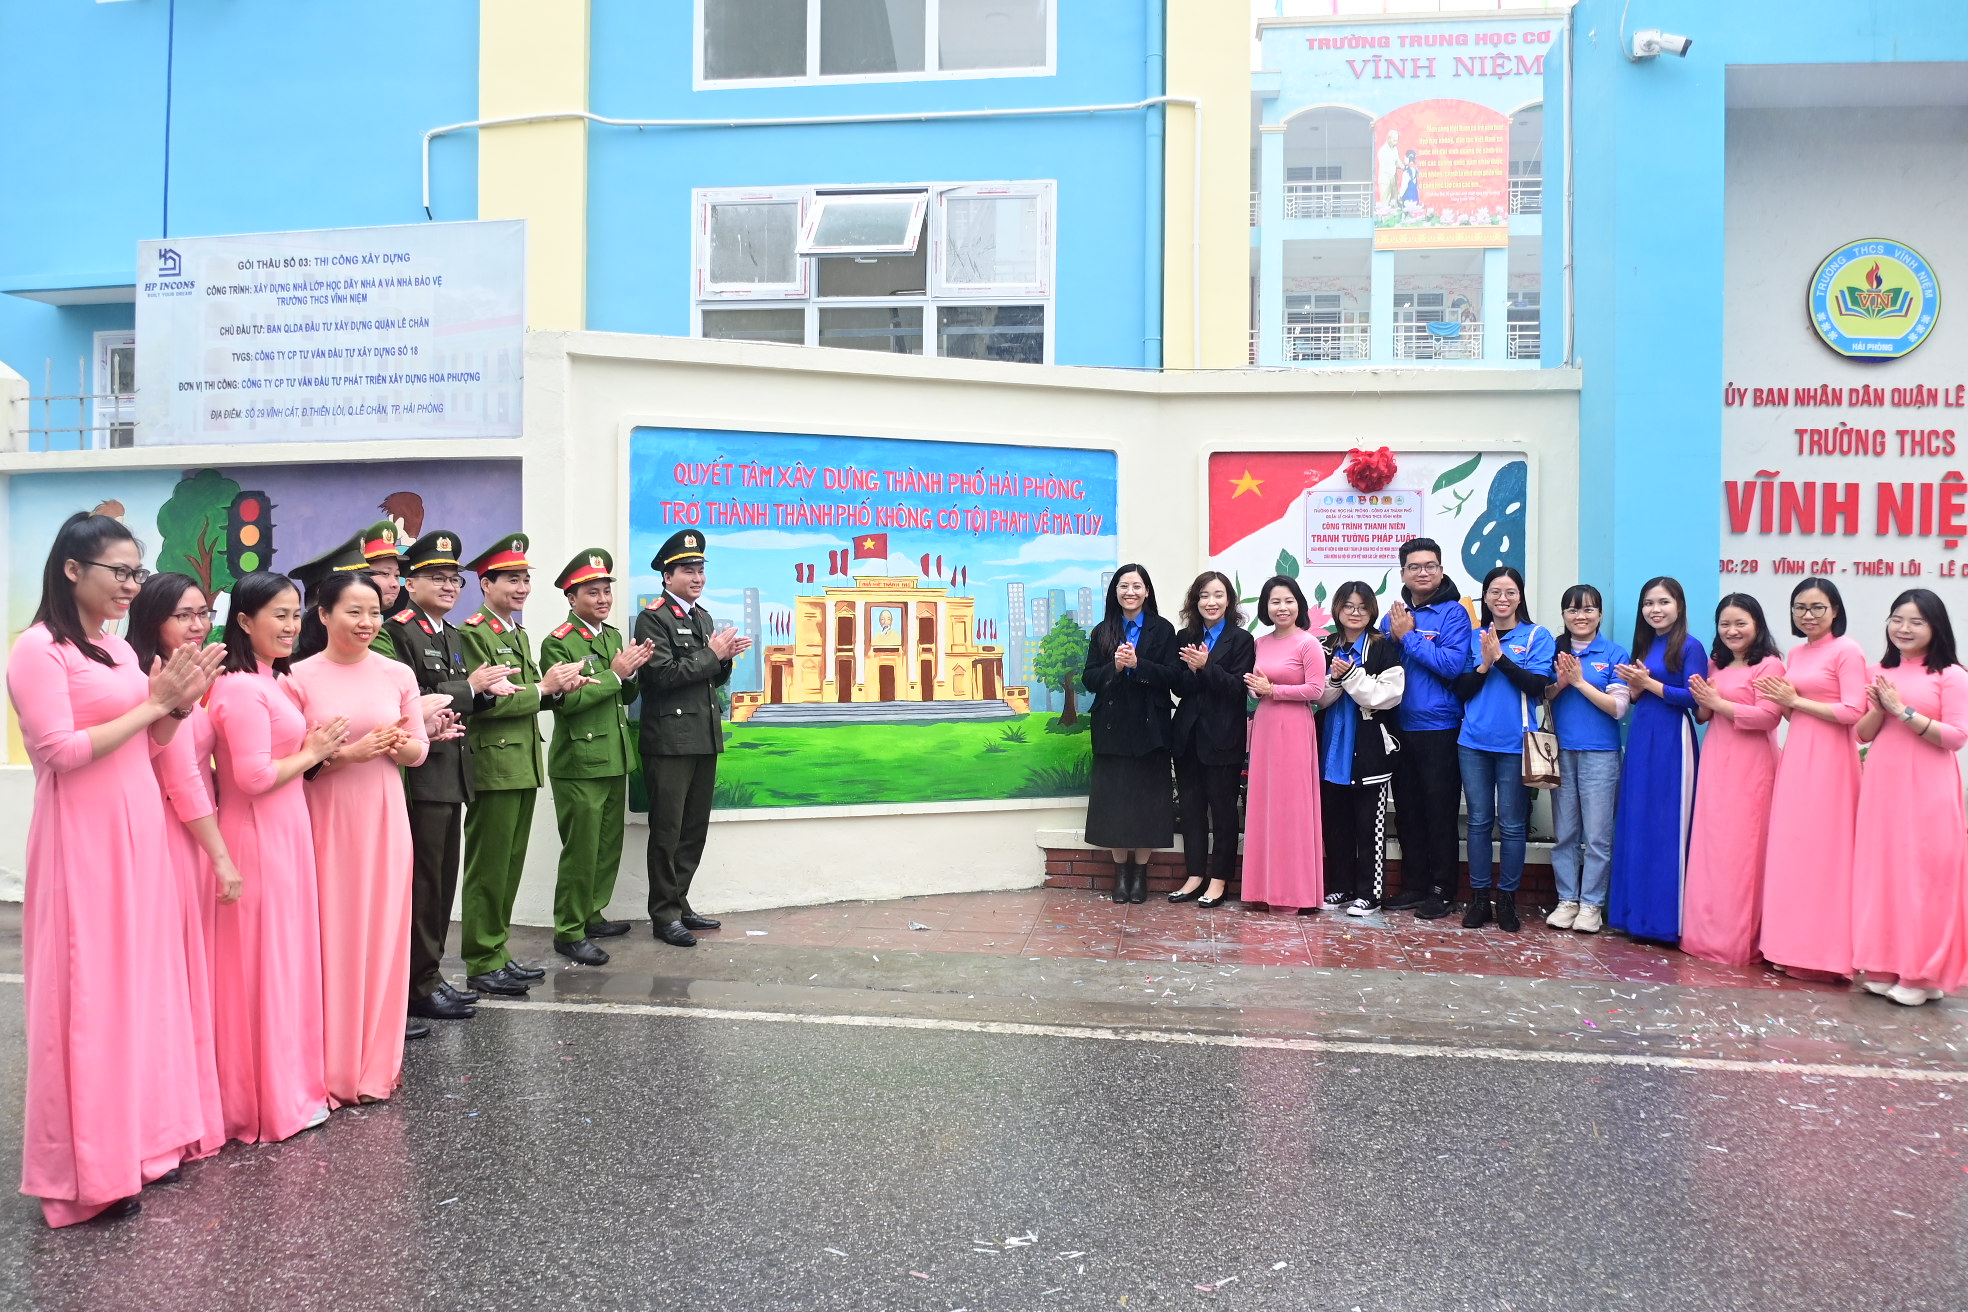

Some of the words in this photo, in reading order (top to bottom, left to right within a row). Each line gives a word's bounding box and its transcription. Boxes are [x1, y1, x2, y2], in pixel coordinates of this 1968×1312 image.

[1306, 34, 1390, 50] TRƯỜNG
[1398, 34, 1468, 47] TRUNG
[1475, 32, 1516, 48] HỌC
[1523, 30, 1550, 44] CƠ
[1346, 54, 1436, 79] VĨNH
[1453, 52, 1544, 80] NIỆM
[238, 260, 254, 270] GÓI
[284, 257, 296, 268] SỐ
[298, 258, 311, 267] 03:
[314, 257, 328, 266] THI
[332, 254, 358, 266] CÔNG
[362, 253, 380, 264] XÂY
[383, 253, 410, 265] DỰNG
[1816, 256, 1847, 297] TRƯỜNG
[1853, 245, 1884, 256] THCS
[144, 283, 157, 291] HP
[160, 281, 196, 290] INCONS
[206, 284, 226, 296] CÔNG
[229, 284, 252, 294] TRÌNH:
[254, 282, 267, 294] XÂY
[270, 282, 290, 294] DỰNG
[292, 280, 308, 292] NHÀ
[310, 281, 324, 291] LỚP
[326, 280, 341, 292] HỌC
[361, 278, 376, 288] NHÀ
[378, 280, 384, 288] A
[385, 277, 395, 288] VÀ
[397, 276, 412, 287] NHÀ
[414, 275, 430, 286] BẢO
[433, 276, 442, 288] VỆ
[277, 296, 307, 306] TRƯỜNG
[310, 294, 328, 304] THCS
[331, 293, 348, 304] VĨNH
[350, 292, 367, 304] NIỆM
[1856, 292, 1894, 309] VN
[266, 324, 281, 334] BAN
[284, 323, 303, 334] QLDA
[322, 322, 332, 331] TƯ
[334, 320, 349, 331] XÂY
[351, 320, 372, 332] DỰNG
[374, 319, 395, 331] QUẬN
[398, 317, 406, 328] LÊ
[408, 316, 430, 328] CHÂN
[232, 352, 253, 362] TVGS:
[255, 350, 275, 361] CÔNG
[277, 351, 286, 360] TY
[288, 350, 297, 360] CP
[300, 350, 310, 359] TƯ
[345, 348, 355, 358] TƯ
[358, 346, 371, 357] XÂY
[374, 346, 396, 358] DỰNG
[410, 346, 418, 356] 18
[1852, 342, 1866, 351] HẢI
[1867, 342, 1894, 352] PHÒNG
[204, 381, 215, 390] THI
[217, 379, 240, 390] CÔNG:
[242, 378, 262, 388] CÔNG
[264, 379, 272, 388] TY
[274, 378, 284, 388] CP
[286, 378, 296, 387] TƯ
[332, 376, 342, 386] TƯ
[344, 374, 363, 386] PHÁT
[388, 373, 403, 384] XÂY
[405, 374, 427, 386] DỰNG
[429, 374, 445, 383] HOA
[447, 372, 480, 384] PHƯỢNG
[1724, 382, 1748, 406] ỦY
[1754, 388, 1789, 407] BAN
[1794, 384, 1843, 407] NHÂN
[1849, 384, 1884, 407] DÂN
[1890, 384, 1938, 409] QUẬN
[1944, 384, 1966, 407] LÊ
[257, 409, 264, 418] 29
[348, 404, 364, 416] Q.LÊ
[391, 405, 400, 414] TP.
[403, 403, 415, 414] HẢI
[416, 402, 444, 414] PHÒNG
[1794, 422, 1886, 456] TRƯỜNG
[1896, 429, 1956, 456] THCS
[674, 455, 734, 486] QUYẾT
[739, 460, 774, 488] TÂM
[777, 462, 817, 488] XÂY
[824, 466, 880, 493] DỰNG
[883, 466, 942, 493] THÀNH
[949, 467, 986, 495] PHỐ
[1024, 472, 1085, 500] PHÒNG
[1724, 469, 1860, 535] VĨNH
[660, 494, 701, 524] TRỞ
[706, 497, 769, 526] THÀNH
[773, 497, 834, 526] THÀNH
[836, 497, 872, 526] PHỐ
[876, 503, 932, 529] KHÔNG
[938, 504, 960, 531] CÓ
[963, 505, 988, 536] TỘI
[990, 511, 1030, 536] PHẠM
[1032, 507, 1050, 534] VỀ
[1053, 514, 1072, 534] MA
[1074, 508, 1103, 536] TÚY
[1322, 521, 1340, 530] CÔNG
[1342, 522, 1362, 530] TRÌNH
[1364, 522, 1386, 530] THANH
[1388, 521, 1406, 530] NIÊN
[1312, 534, 1339, 542] TRANH
[1372, 532, 1394, 542] PHÁP
[1773, 558, 1805, 574] VĨNH
[1811, 558, 1836, 574] CÁT
[1854, 559, 1894, 576] THIÊN
[1901, 559, 1921, 576] LÔI
[1940, 560, 1955, 577] LÊ
